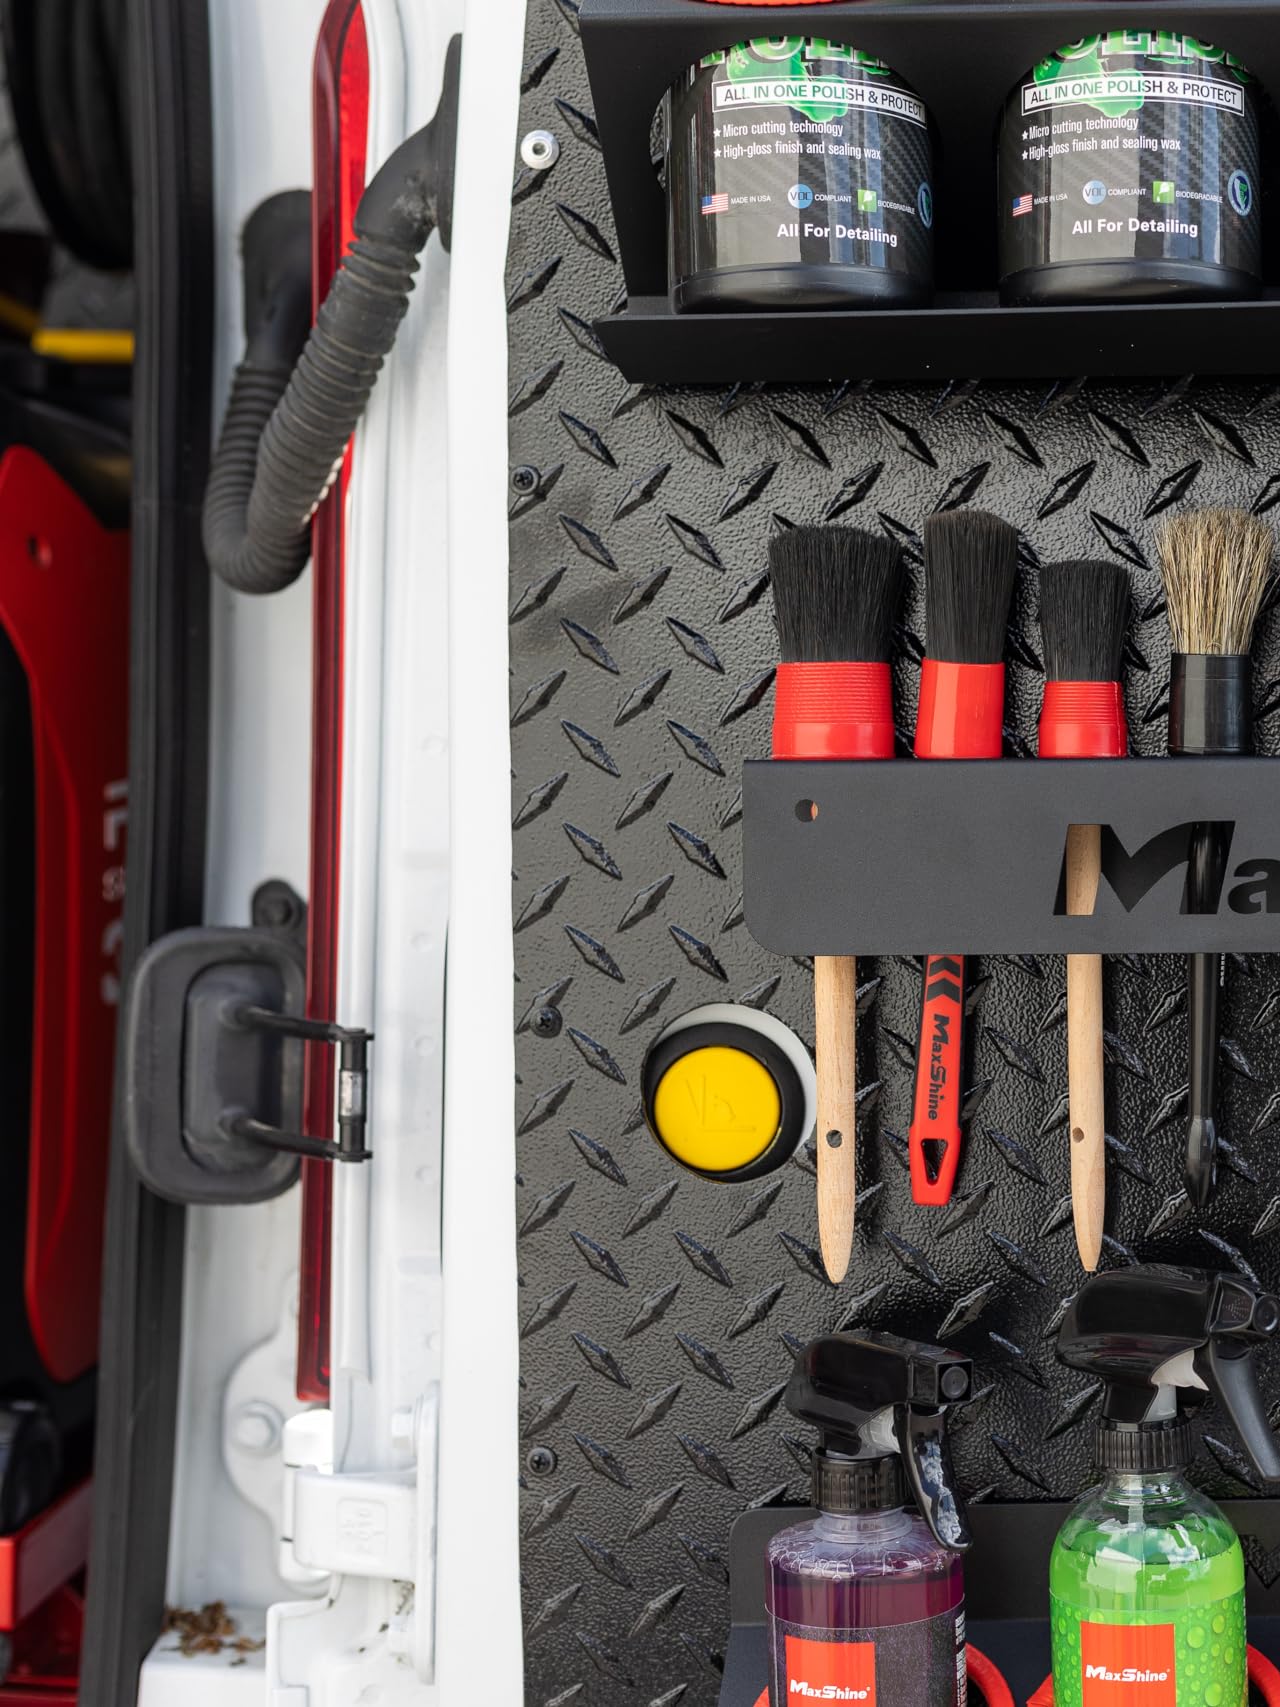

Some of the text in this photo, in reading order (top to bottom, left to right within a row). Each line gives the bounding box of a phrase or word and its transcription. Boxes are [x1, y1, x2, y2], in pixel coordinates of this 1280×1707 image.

[724, 84, 923, 117] ALL IN ONE POLISH & PROTECT
[1030, 80, 1237, 105] ALL IN ONE POLISH & PROTECT
[723, 120, 844, 138] Micro cutting technology
[1029, 116, 1139, 140] Micro cutting technology
[723, 141, 881, 160] High-gloss finish and sealing wax
[1029, 137, 1181, 160] High-gloss finish and sealing wax
[757, 195, 771, 203] USA
[814, 194, 852, 203] COMPLIANT
[1055, 193, 1068, 202] USA
[777, 223, 897, 247] All For Detailing
[1072, 218, 1198, 238] All For Detailing
[928, 1013, 950, 1121] MaxShine
